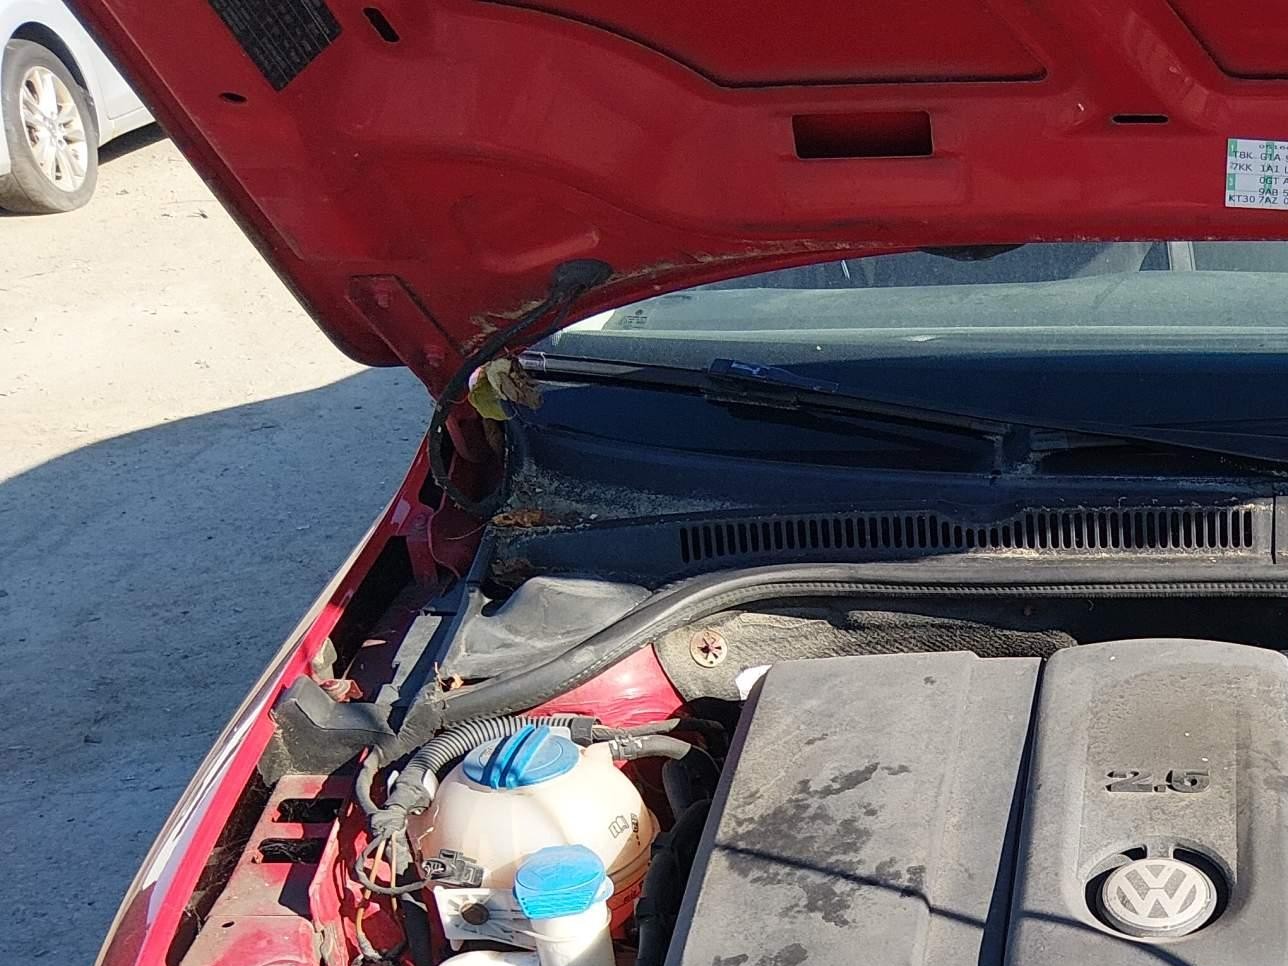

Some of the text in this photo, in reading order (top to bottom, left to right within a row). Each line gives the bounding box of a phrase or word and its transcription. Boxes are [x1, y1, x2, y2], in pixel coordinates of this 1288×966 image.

[1260, 153, 1280, 161] G1A
[1232, 163, 1252, 172] 7KK
[1261, 164, 1280, 173] 1A1
[1258, 188, 1278, 196] 9AB
[1228, 194, 1256, 203] KT30
[1258, 196, 1278, 204] 7AZ
[1105, 770, 1211, 793] 2.5
[1104, 860, 1213, 928] VW
